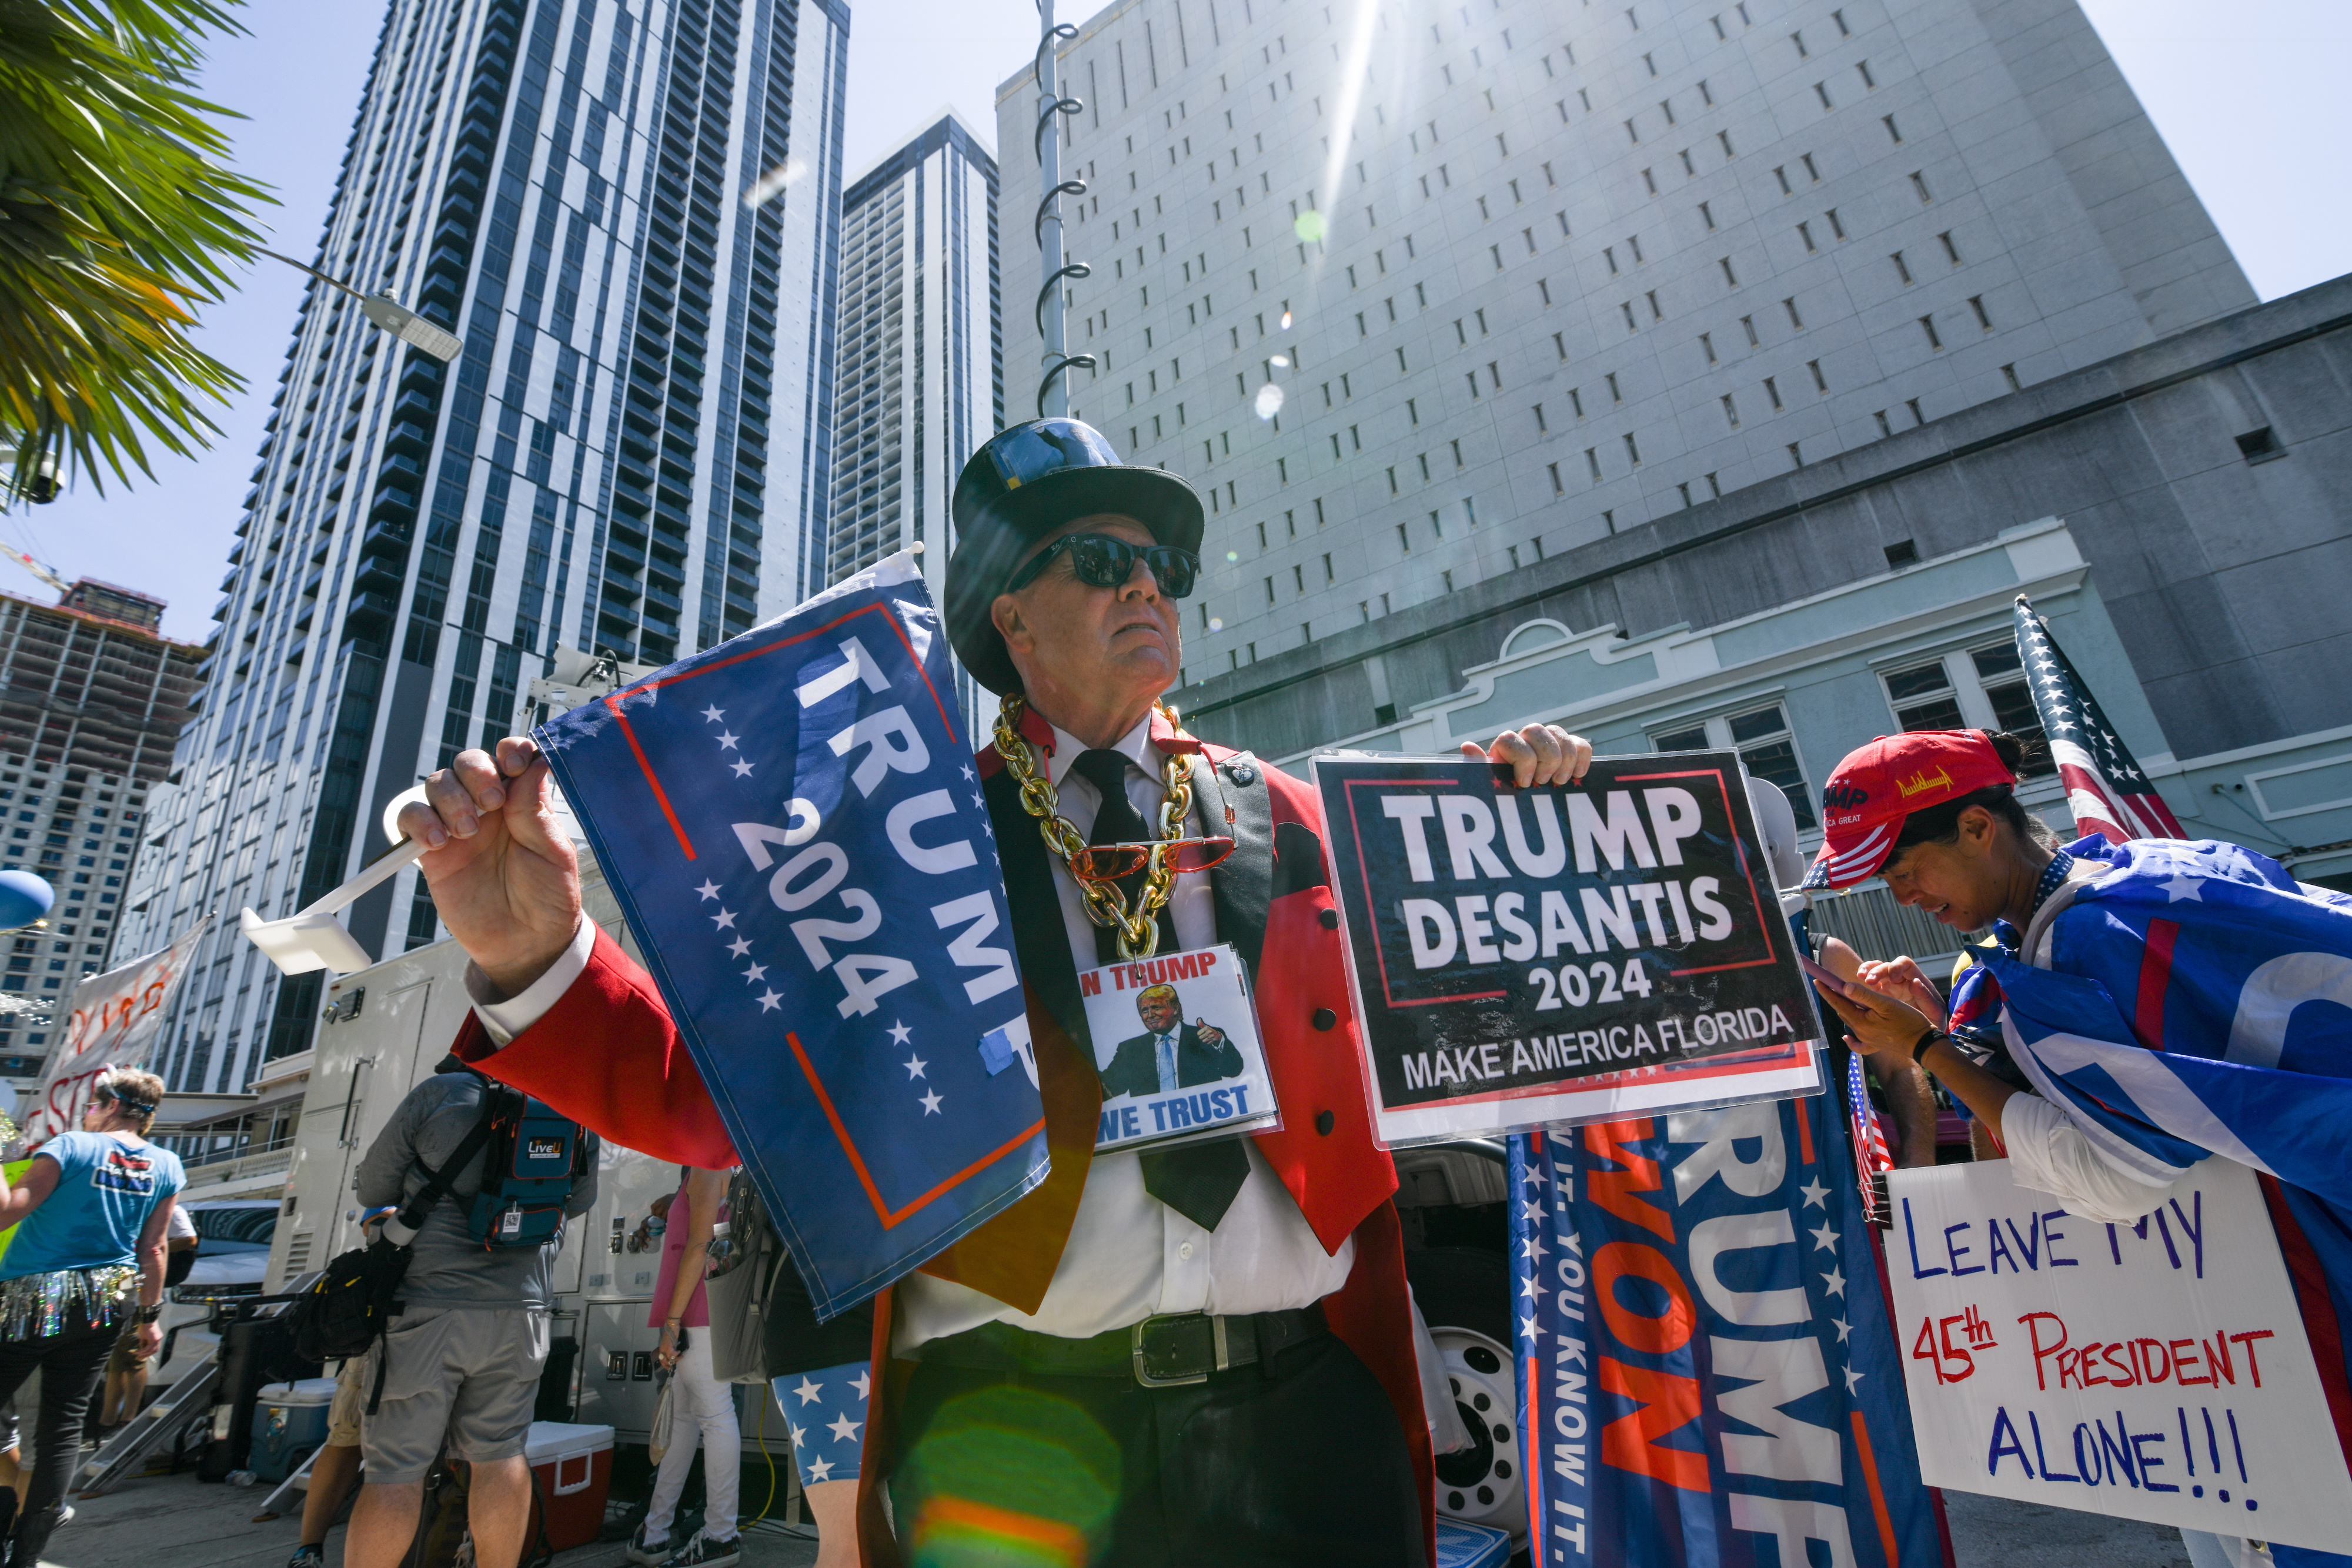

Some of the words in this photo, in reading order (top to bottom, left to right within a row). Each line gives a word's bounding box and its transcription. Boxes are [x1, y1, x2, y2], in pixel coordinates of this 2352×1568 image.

[1382, 787, 1702, 883] TRUMP
[1823, 785, 1868, 810] UMP
[1839, 814, 1860, 824] GREAT
[794, 636, 1040, 1091] TRUMP
[732, 798, 918, 1019] 2024
[1404, 876, 1732, 969] DESANTIS
[1081, 970, 1101, 997] N
[1110, 952, 1217, 991] TRUMP
[1529, 959, 1651, 1012] 2024
[1401, 1042, 1505, 1091] MAKE
[1512, 1022, 1653, 1075] AMERICA
[1656, 1004, 1794, 1053] FLORIDA
[1095, 1105, 1141, 1144] WE
[1148, 1085, 1248, 1132] TRUST
[1554, 1162, 1573, 1211] IT.
[1556, 1231, 1585, 1322] YOU
[1902, 1197, 2079, 1279] LEAVE
[2107, 1191, 2203, 1279] MY
[1583, 1118, 1711, 1493] WON
[1666, 1101, 1857, 1568] RUMP
[1913, 1304, 1998, 1386] 45th
[2017, 1311, 2274, 1391] PRESIDENT
[1553, 1335, 1587, 1486] KNOW
[1988, 1406, 2258, 1512] ALONE!!!
[1554, 1499, 1585, 1563] IT.
